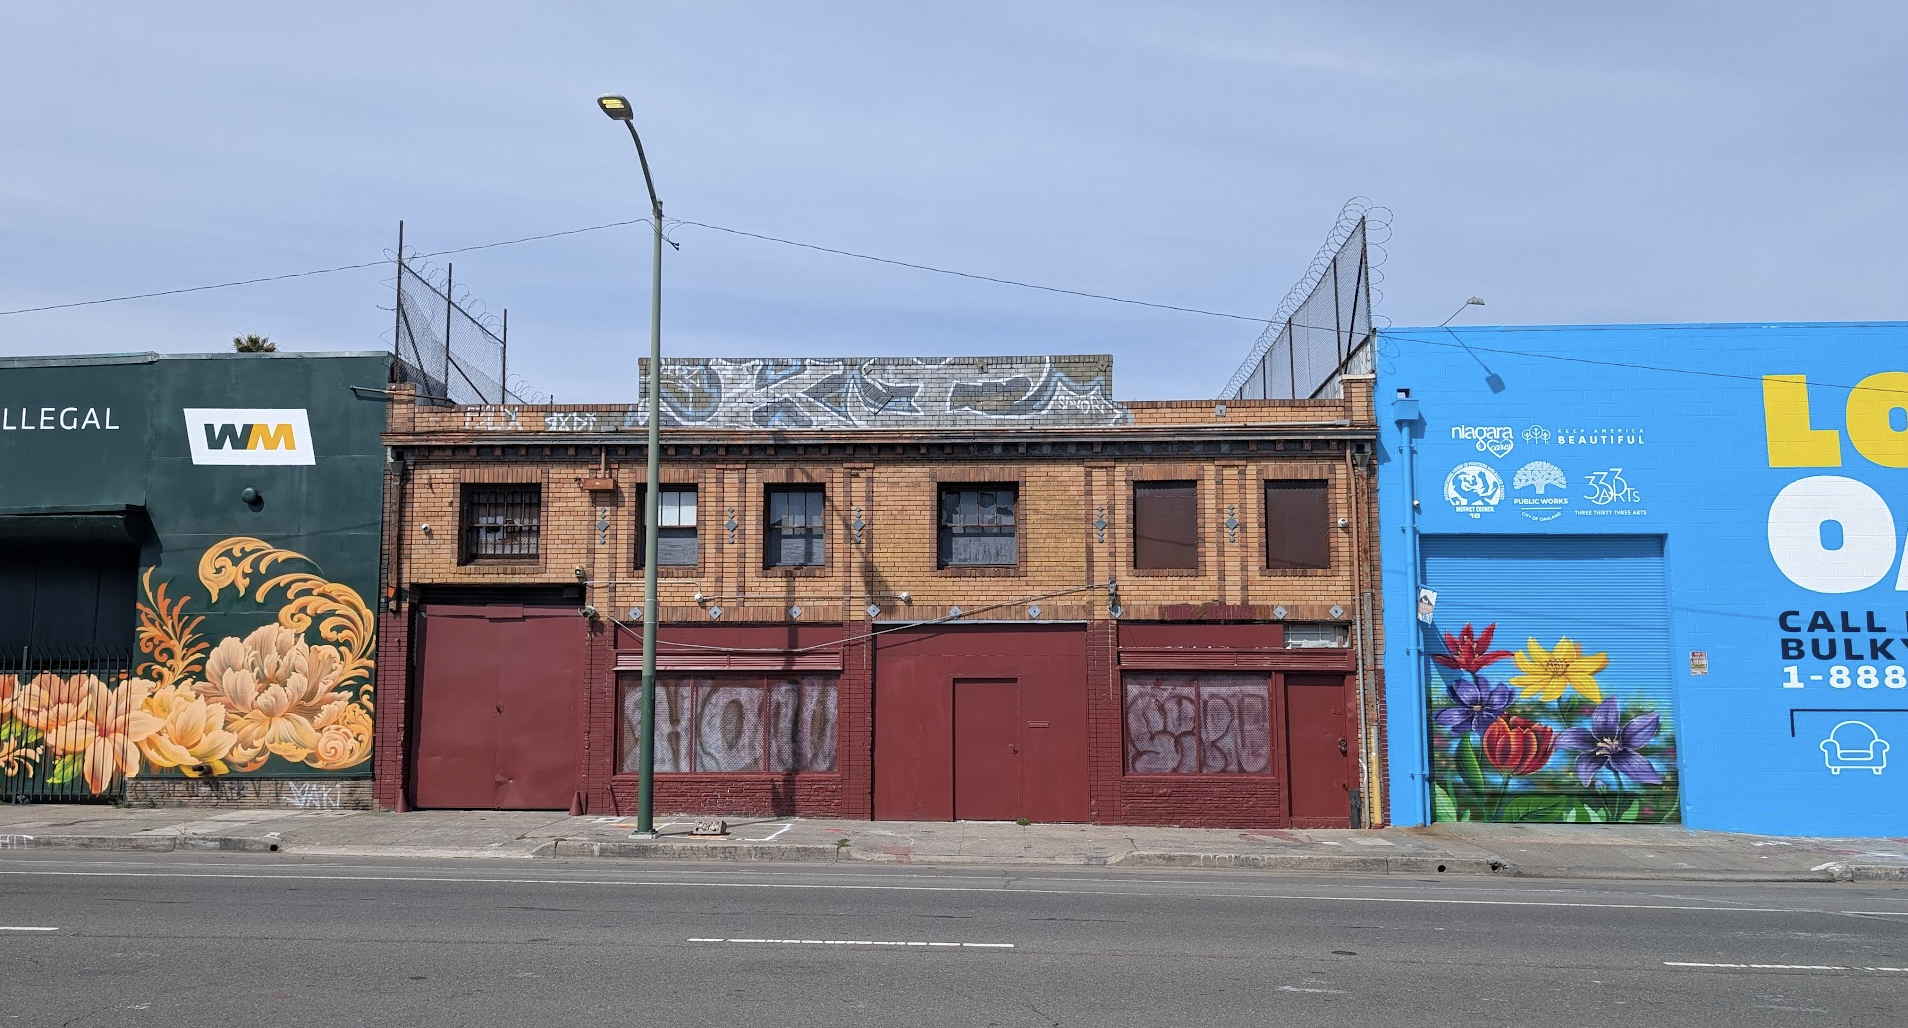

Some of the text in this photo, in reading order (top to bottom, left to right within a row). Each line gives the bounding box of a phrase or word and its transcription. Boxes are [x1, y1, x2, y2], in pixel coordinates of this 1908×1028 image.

[2, 407, 120, 431] LLEGAL
[1762, 371, 1908, 468] LO
[203, 423, 297, 451] WM
[1451, 425, 1514, 452] niagara
[1557, 435, 1645, 445] BEAUTIFUL
[1540, 497, 1569, 505] WORKS
[1521, 511, 1532, 519] CITY
[1539, 511, 1562, 522] OAKLAND
[1767, 475, 1908, 594] O
[1778, 610, 1887, 633] CALL
[1782, 664, 1907, 690] 1-888
